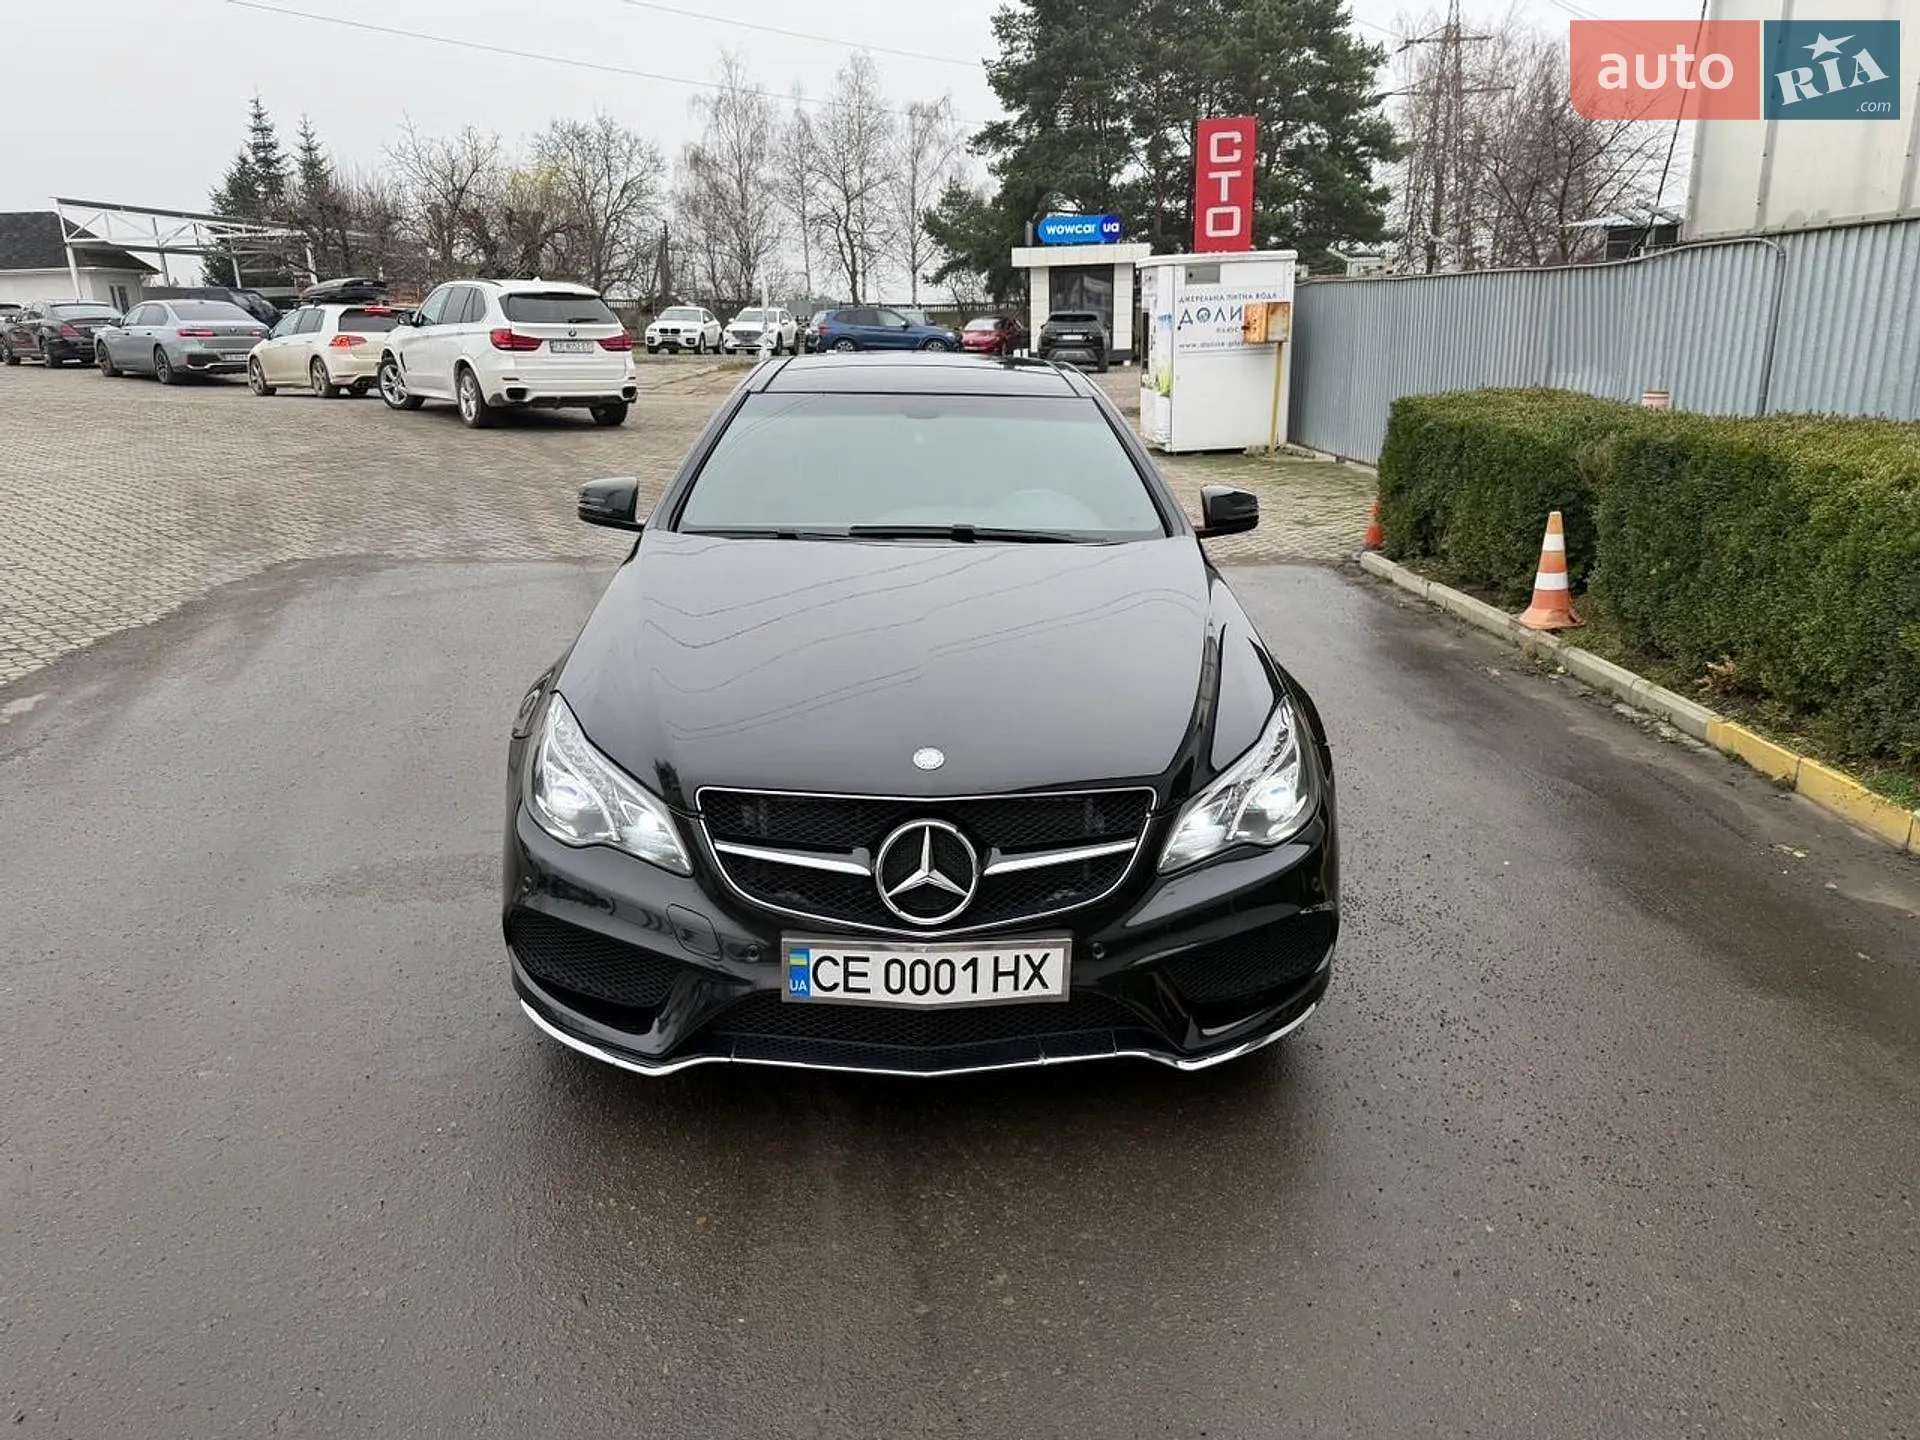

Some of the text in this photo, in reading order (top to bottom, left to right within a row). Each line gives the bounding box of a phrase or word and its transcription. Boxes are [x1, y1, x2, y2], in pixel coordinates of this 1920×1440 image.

[1205, 131, 1242, 238] СТО
[1045, 221, 1120, 235] wowcar ua
[1177, 305, 1243, 331] ДОЛИ
[789, 979, 807, 992] UA
[811, 952, 1050, 996] CE 0001 HX
